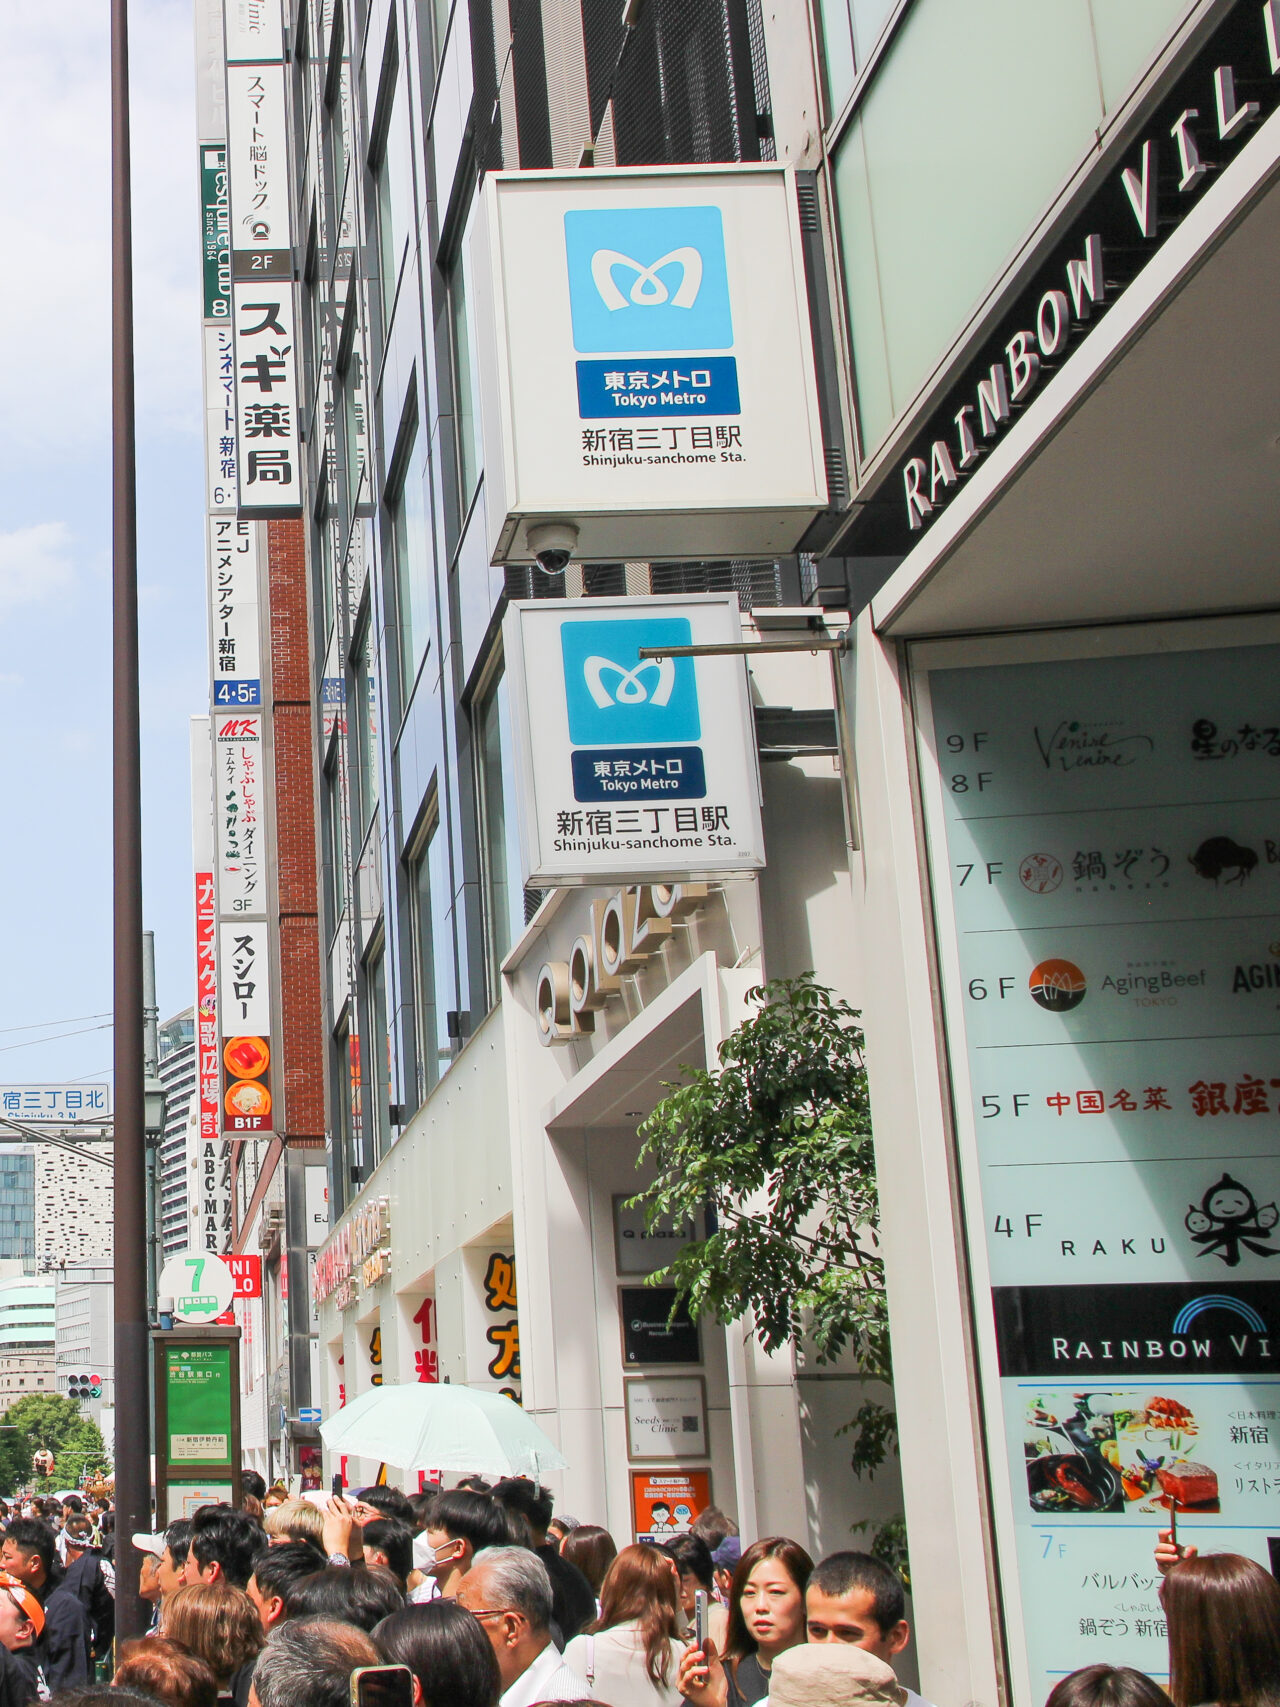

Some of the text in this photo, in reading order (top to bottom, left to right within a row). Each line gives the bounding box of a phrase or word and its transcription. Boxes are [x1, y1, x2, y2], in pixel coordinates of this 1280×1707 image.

[247, 76, 268, 210] スマート脳ドック
[207, 240, 216, 261] 1964
[251, 256, 273, 270] 2F
[603, 370, 712, 391] 東京メトロ
[903, 234, 1105, 530] RAINBOW
[218, 332, 236, 479] シネマート新宿
[239, 302, 292, 486] スギ薬局
[612, 392, 707, 408] Tokyo Metro
[582, 425, 742, 452] 新宿三丁目駅
[583, 451, 746, 468] Shinjuku-sanchome Sta.
[237, 521, 249, 553] EJ
[216, 521, 236, 672] アニメシアター新宿
[219, 719, 258, 736] MK
[946, 732, 989, 753] 9F
[593, 758, 683, 777] 東京メトロ
[600, 778, 679, 793] Tokyo Metro
[951, 772, 993, 793] 8F
[240, 746, 258, 895] しゃぶしゃぶ ダイニング
[556, 805, 730, 836] 新宿三丁目駅
[554, 834, 737, 854] Shinjuku-sanchome Sta.
[956, 862, 1003, 886] 7F
[1072, 848, 1170, 881] 鍋ぞう
[233, 899, 252, 911] 3F
[198, 879, 216, 990] カラオケ
[232, 935, 257, 1020] スシロー
[969, 977, 1015, 1000] 6F
[200, 1021, 219, 1103] 歌広場
[982, 1094, 1030, 1118] 5F
[1046, 1087, 1172, 1116] 中国名菜
[234, 1117, 262, 1129] B1F
[994, 1214, 1042, 1238] 4F
[1061, 1237, 1166, 1256] RAKU
[184, 1258, 206, 1293] 7
[634, 1415, 660, 1424] Seeds
[651, 1424, 678, 1432] Clinic
[1229, 1425, 1269, 1444] 新宿
[1040, 1535, 1067, 1559] 7F
[1079, 1618, 1129, 1637] 鍋ぞう
